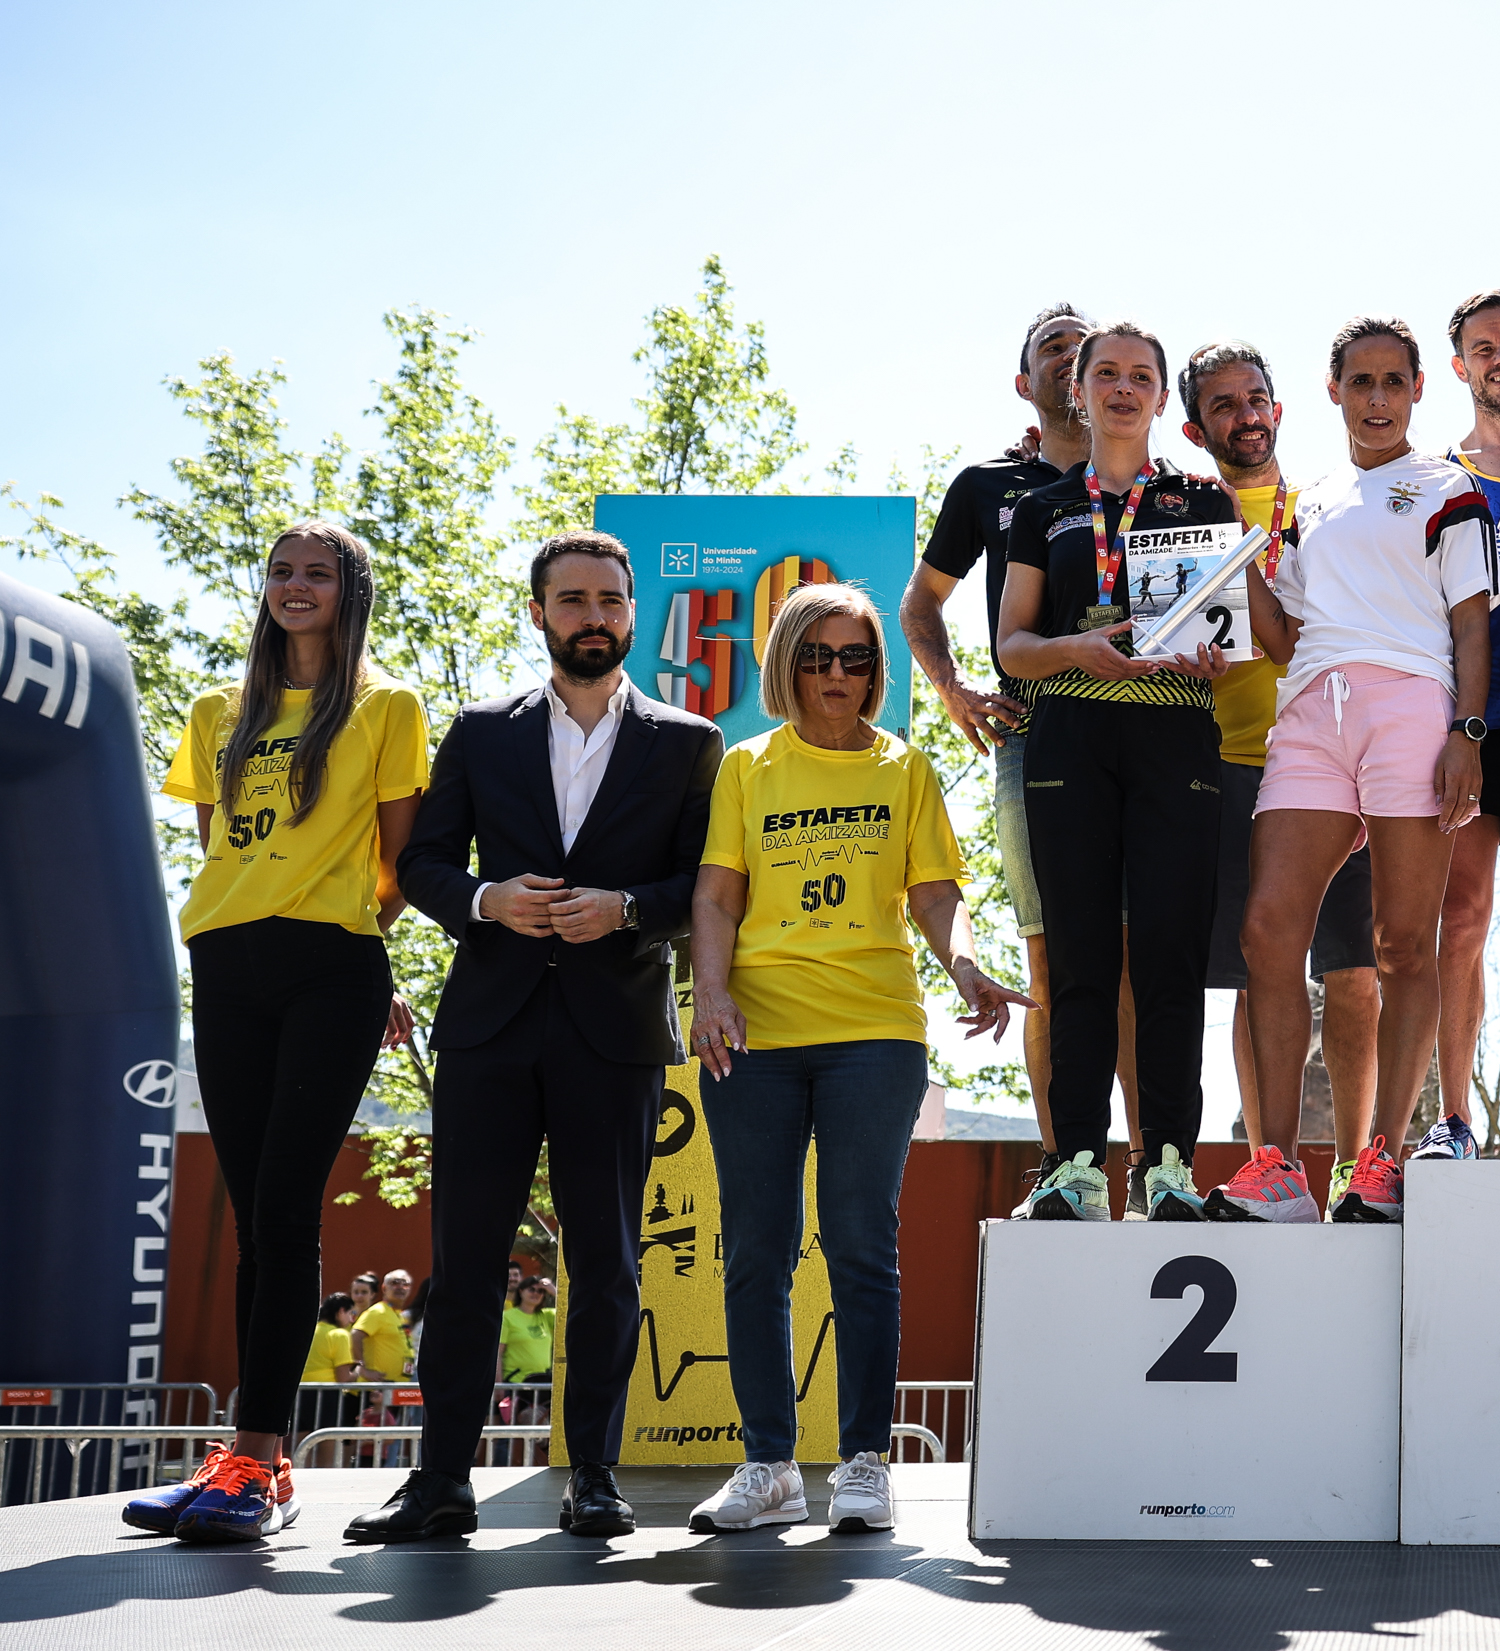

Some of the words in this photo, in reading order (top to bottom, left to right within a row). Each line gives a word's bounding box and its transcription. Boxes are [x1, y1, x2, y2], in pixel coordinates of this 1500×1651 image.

[703, 547, 757, 555] Universidade
[1129, 529, 1213, 549] ESTAFETA
[1141, 547, 1173, 556] AMIZADE
[702, 566, 743, 574] 1974-2024
[1206, 605, 1235, 650] 2
[0, 610, 91, 729] AI
[227, 807, 277, 850] 50
[763, 804, 891, 834] ESTAFETA
[762, 832, 793, 851] DA
[795, 824, 890, 846] AMIZADE
[800, 872, 847, 913] 50
[122, 1133, 172, 1471] HYUNDAI
[1145, 1255, 1238, 1382] 2
